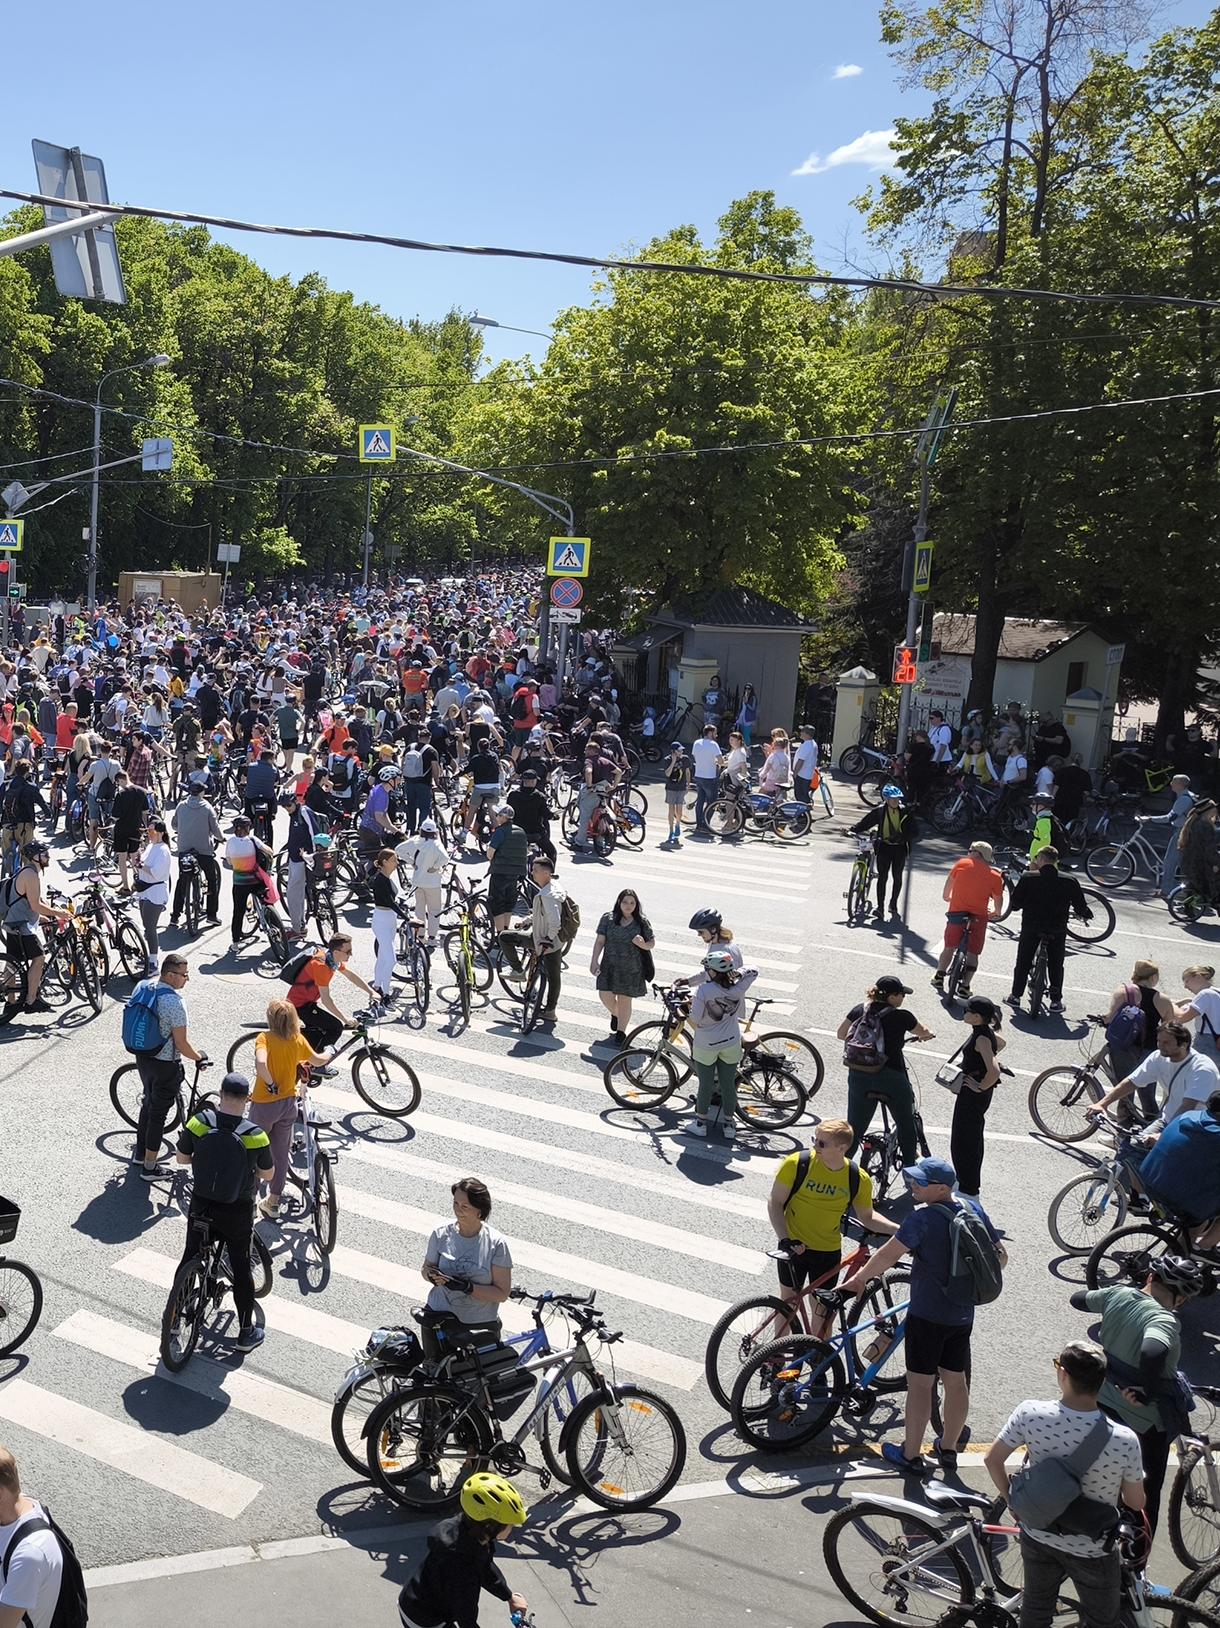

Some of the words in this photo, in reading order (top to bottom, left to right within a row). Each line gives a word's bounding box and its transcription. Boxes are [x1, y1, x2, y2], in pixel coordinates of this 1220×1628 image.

[895, 664, 916, 683] 20
[134, 1021, 146, 1049] PUMA
[805, 1179, 837, 1197] RUN
[526, 1376, 567, 1432] MERIDA
